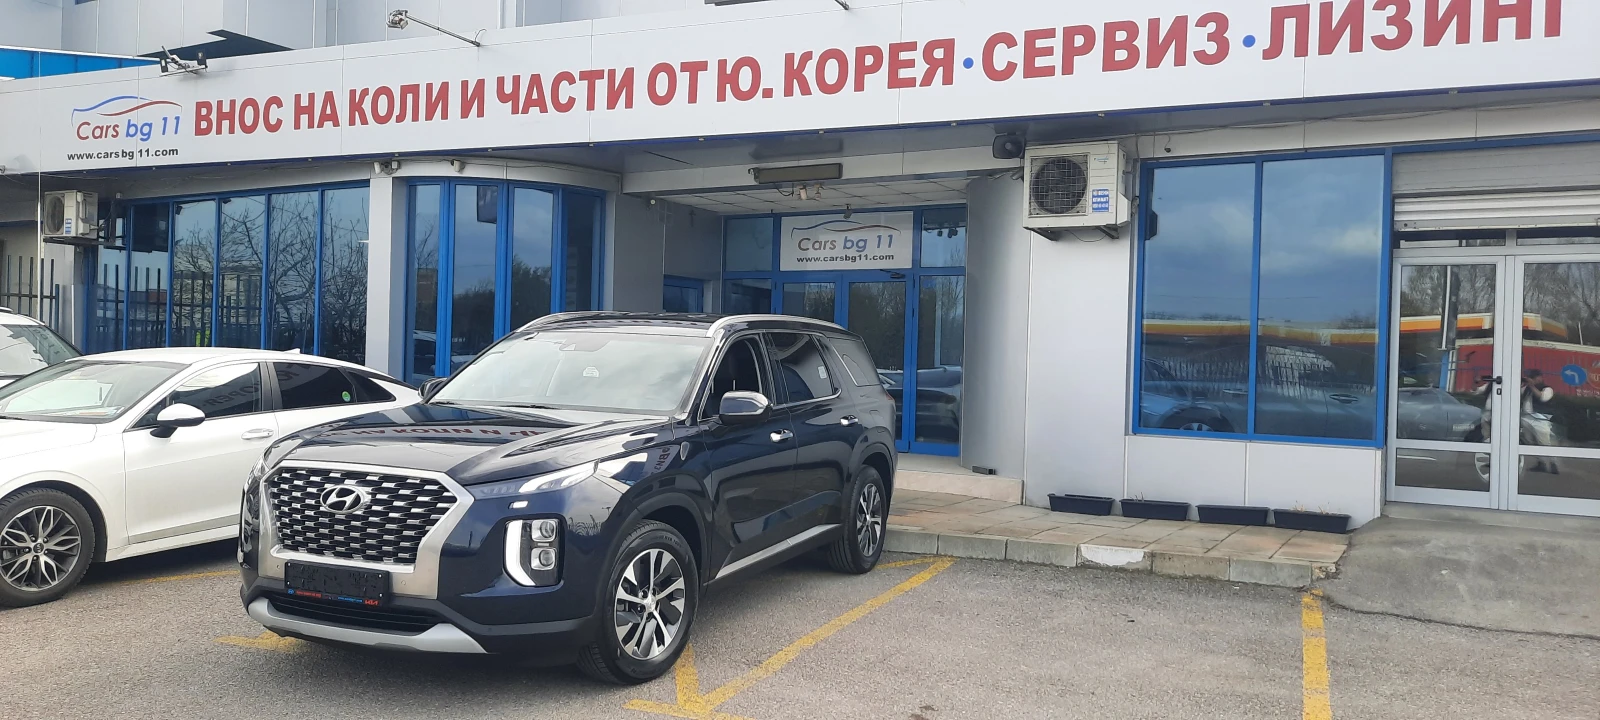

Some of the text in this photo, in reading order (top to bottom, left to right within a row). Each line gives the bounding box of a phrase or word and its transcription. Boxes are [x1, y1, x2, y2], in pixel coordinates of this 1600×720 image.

[194, 95, 283, 136] ВНОС
[293, 91, 340, 130] НА
[348, 82, 449, 126] КОЛИ
[460, 78, 485, 119] И
[496, 69, 635, 115] ЧАСТИ
[647, 60, 708, 106] ОТ
[716, 56, 774, 103] Ю.
[783, 38, 955, 97] КОРЕЯ
[982, 12, 1230, 82] СЕРВИЗ
[76, 116, 181, 142] Cars bg 11
[67, 147, 179, 161] www.carsbg11.com
[797, 234, 894, 253] Cars bg 11
[796, 253, 895, 263] www.carsbg11.com
